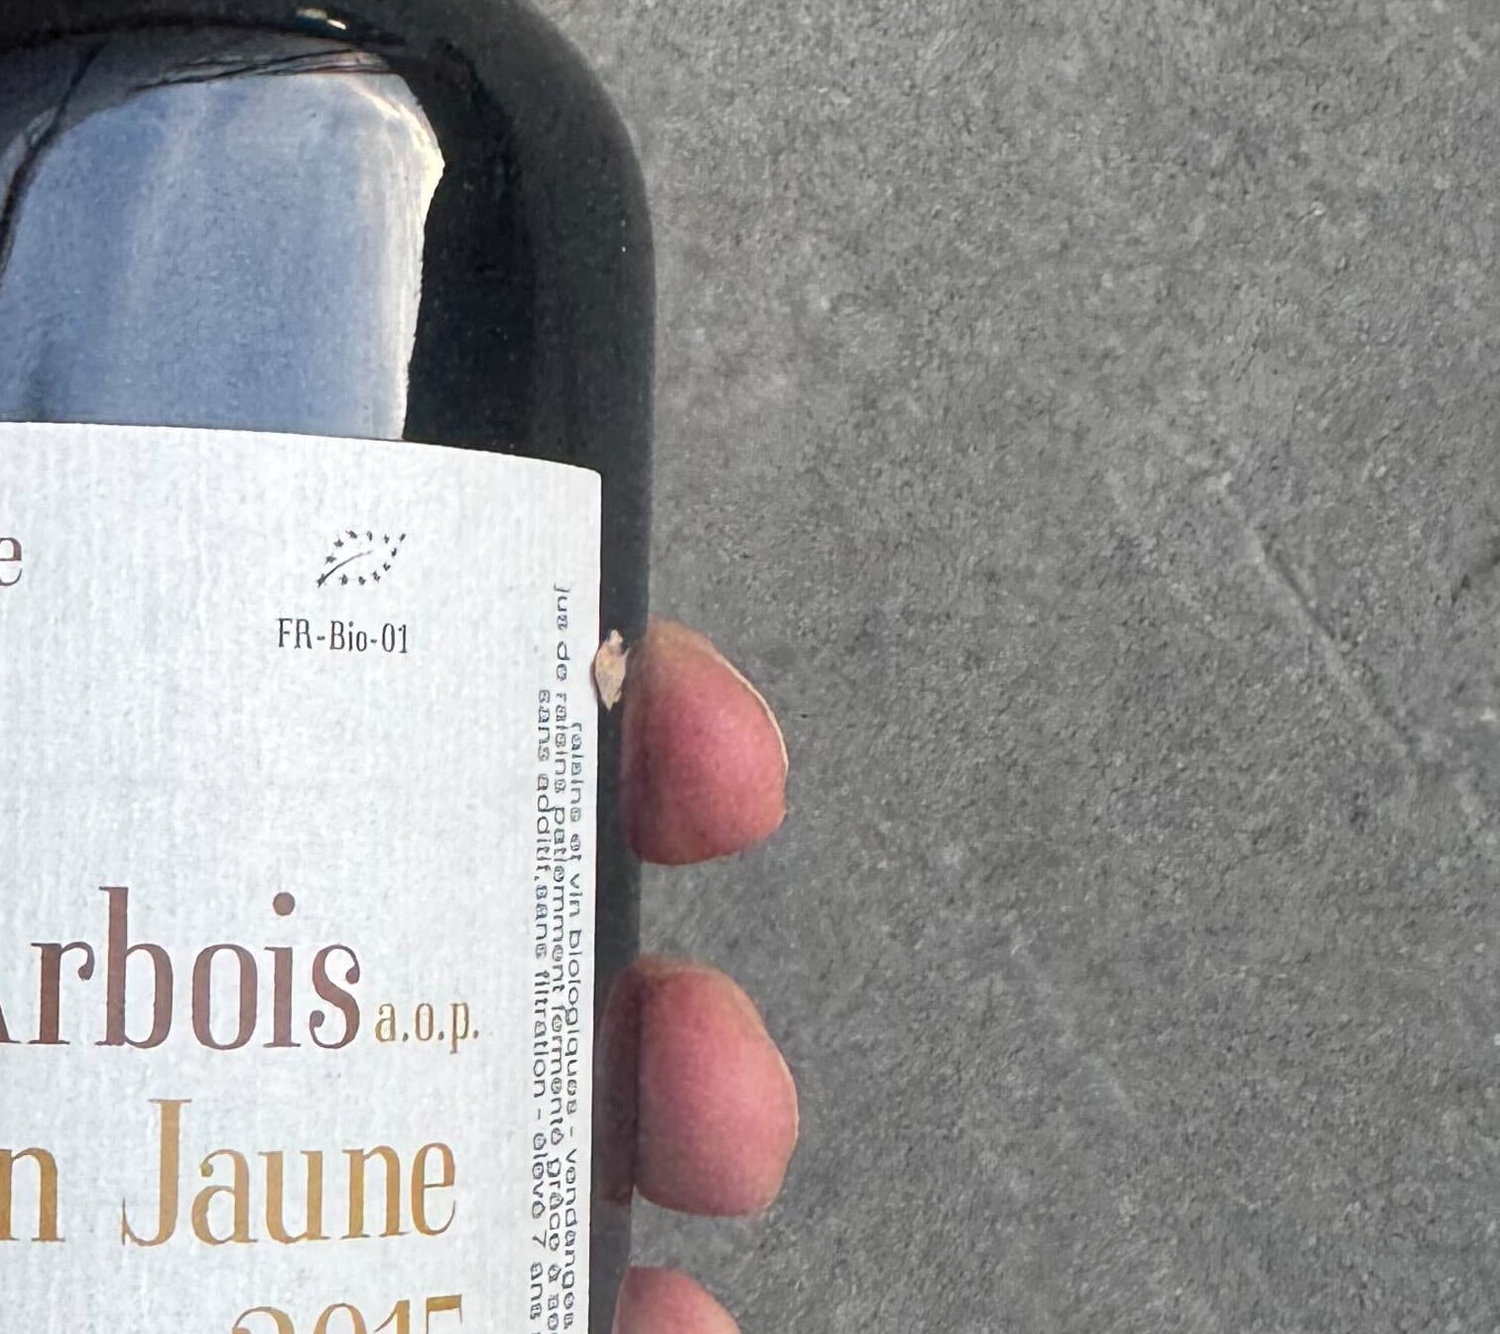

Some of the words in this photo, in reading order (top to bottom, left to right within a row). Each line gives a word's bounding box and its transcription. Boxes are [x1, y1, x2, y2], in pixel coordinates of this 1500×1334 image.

[277, 618, 407, 653] FR-Bio-01
[554, 585, 570, 631] jus
[556, 641, 570, 681] de
[538, 689, 551, 761] sans
[554, 693, 568, 794] raisins
[570, 723, 584, 822] raisins
[568, 834, 582, 860] et
[551, 807, 568, 993] patiemment
[569, 873, 582, 918] vin
[375, 1002, 479, 1054] a.o.p.
[534, 970, 549, 1098] filtration
[565, 930, 582, 1115] biologiques
[121, 1099, 455, 1246] Jaune
[532, 1230, 546, 1247] 7
[562, 1149, 577, 1329] vendanges
[530, 1262, 543, 1320] ans
